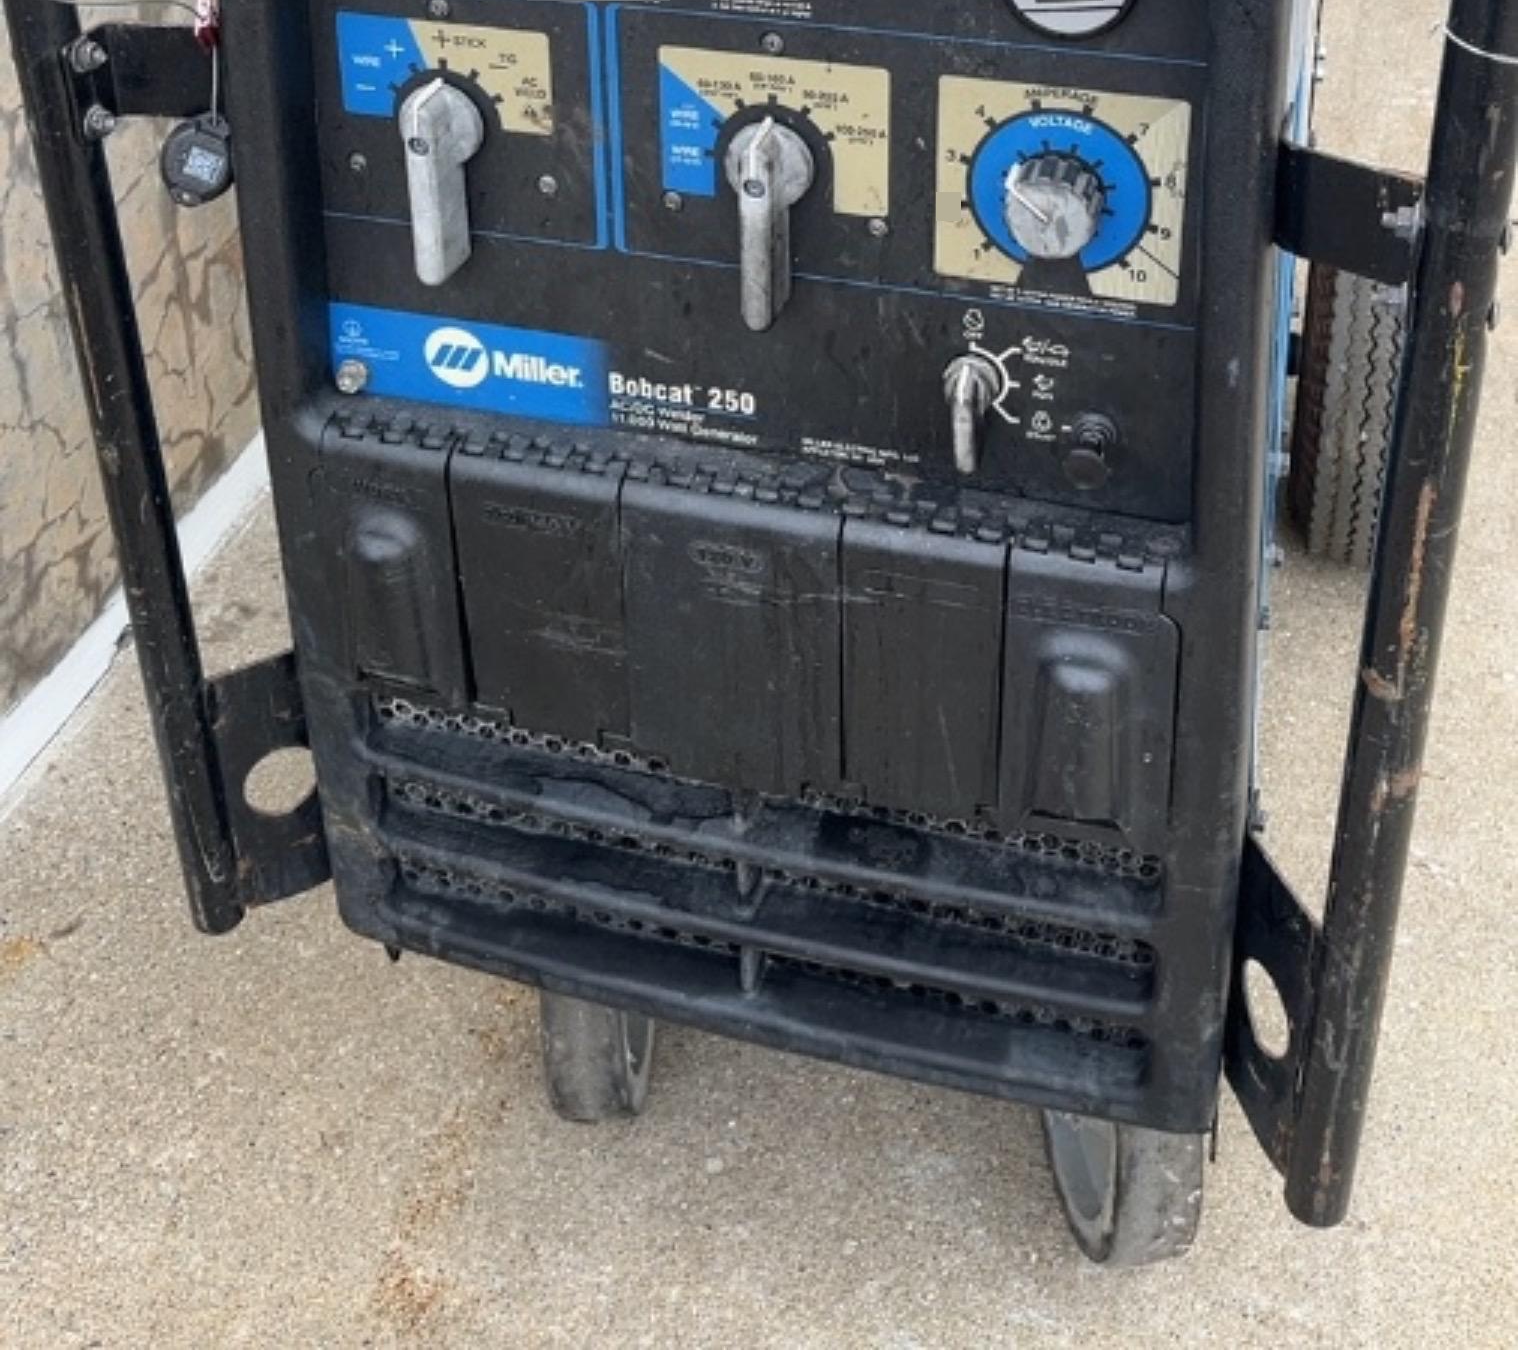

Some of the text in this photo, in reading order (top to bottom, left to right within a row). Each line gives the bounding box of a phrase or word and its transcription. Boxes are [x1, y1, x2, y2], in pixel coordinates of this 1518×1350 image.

[453, 38, 487, 49] STICK
[352, 54, 381, 67] WIRE
[498, 53, 517, 64] TIG
[521, 77, 538, 88] AC
[1025, 88, 1099, 104] AMPERAGE
[671, 110, 699, 121] WIRE
[974, 104, 985, 117] 4
[1028, 114, 1094, 136] VOLTAGE
[1139, 123, 1150, 136] 7
[671, 145, 700, 157] WIRE
[945, 150, 957, 162] 3
[1164, 175, 1177, 190] 8
[1159, 227, 1171, 240] 9
[1129, 269, 1147, 283] 10
[706, 387, 755, 415] 250
[608, 398, 706, 422] AC/DC Welder
[658, 417, 689, 434] Watt
[690, 420, 759, 445] Generator
